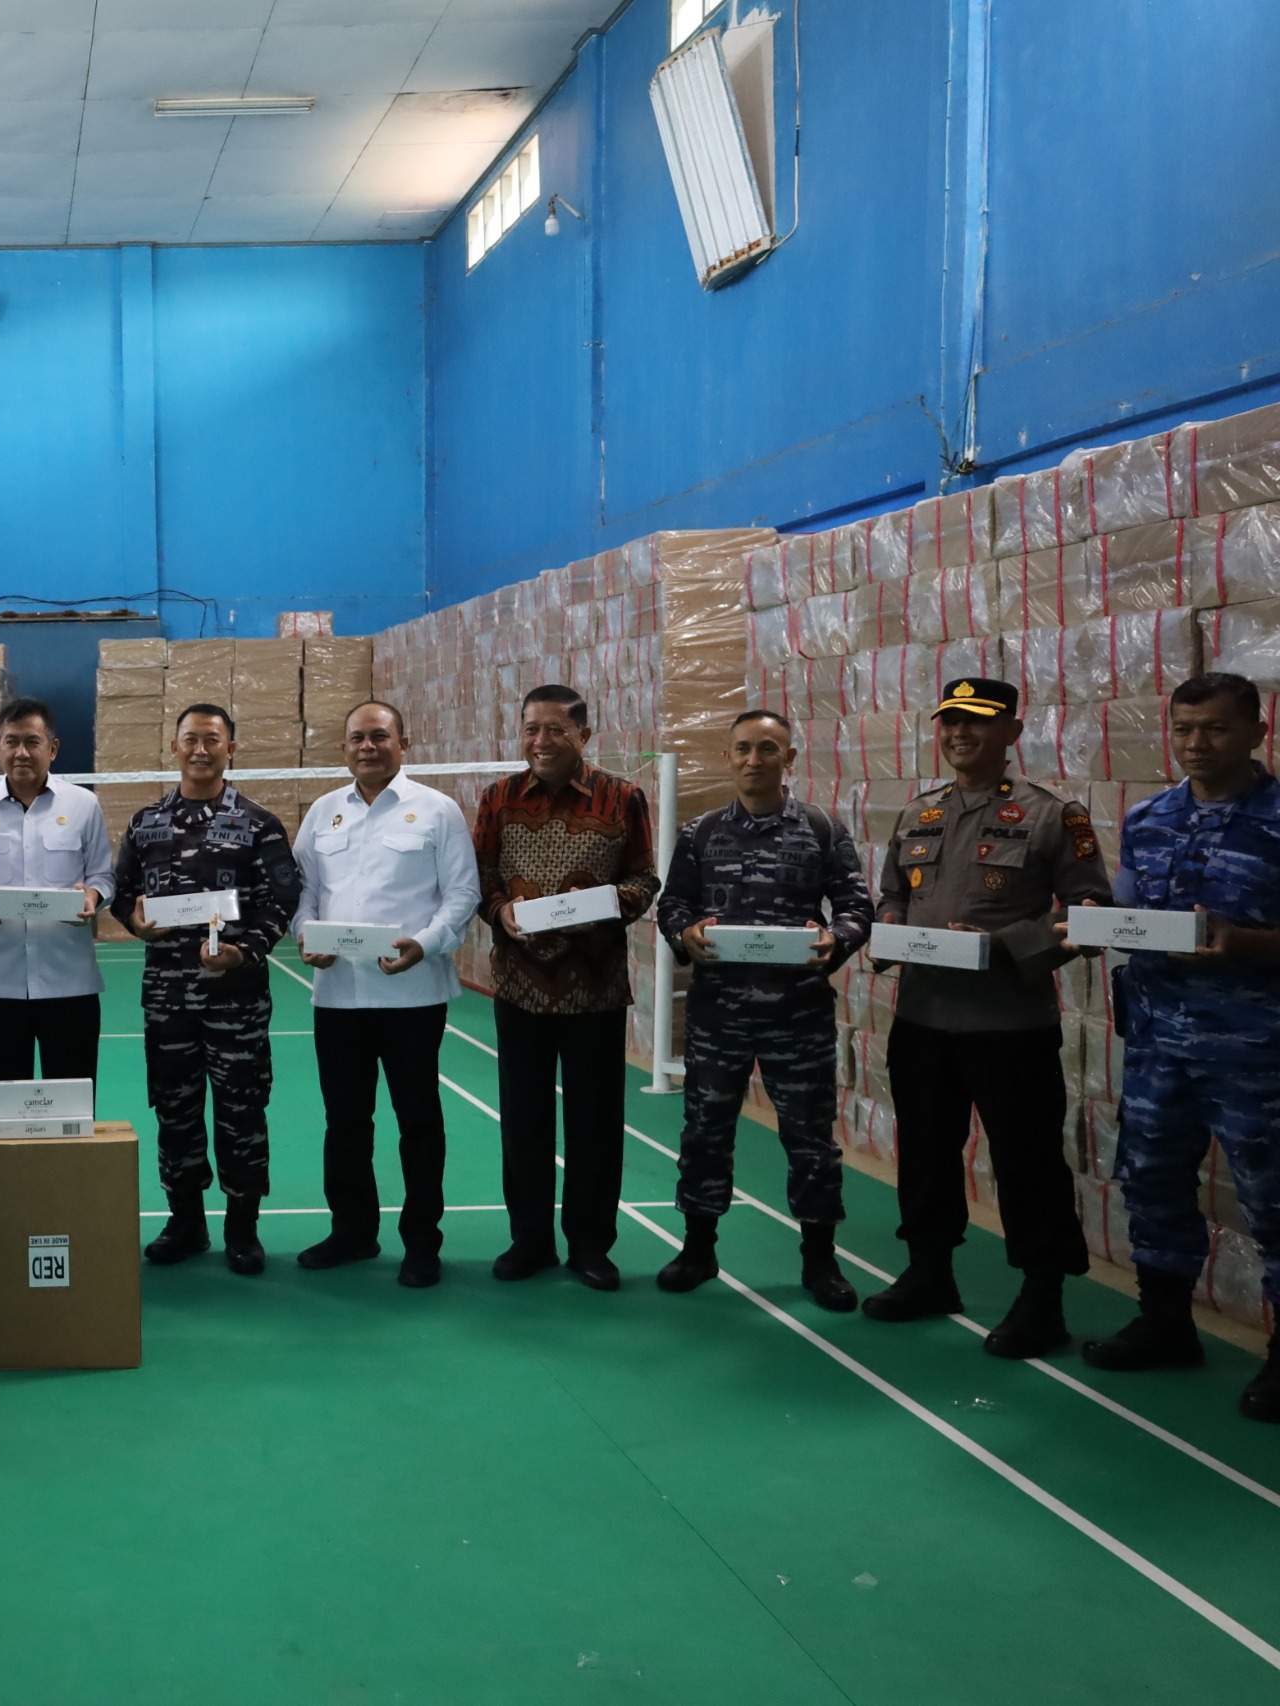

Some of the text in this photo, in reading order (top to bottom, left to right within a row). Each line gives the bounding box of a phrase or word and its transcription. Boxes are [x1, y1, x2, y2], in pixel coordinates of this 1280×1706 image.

[139, 830, 168, 842] HARIS
[211, 830, 249, 843] TNI AL
[778, 851, 802, 861] TNI
[1112, 926, 1147, 936] camclar
[43, 1236, 50, 1244] IN
[52, 1236, 68, 1244] MADE
[32, 1256, 65, 1280] RED
